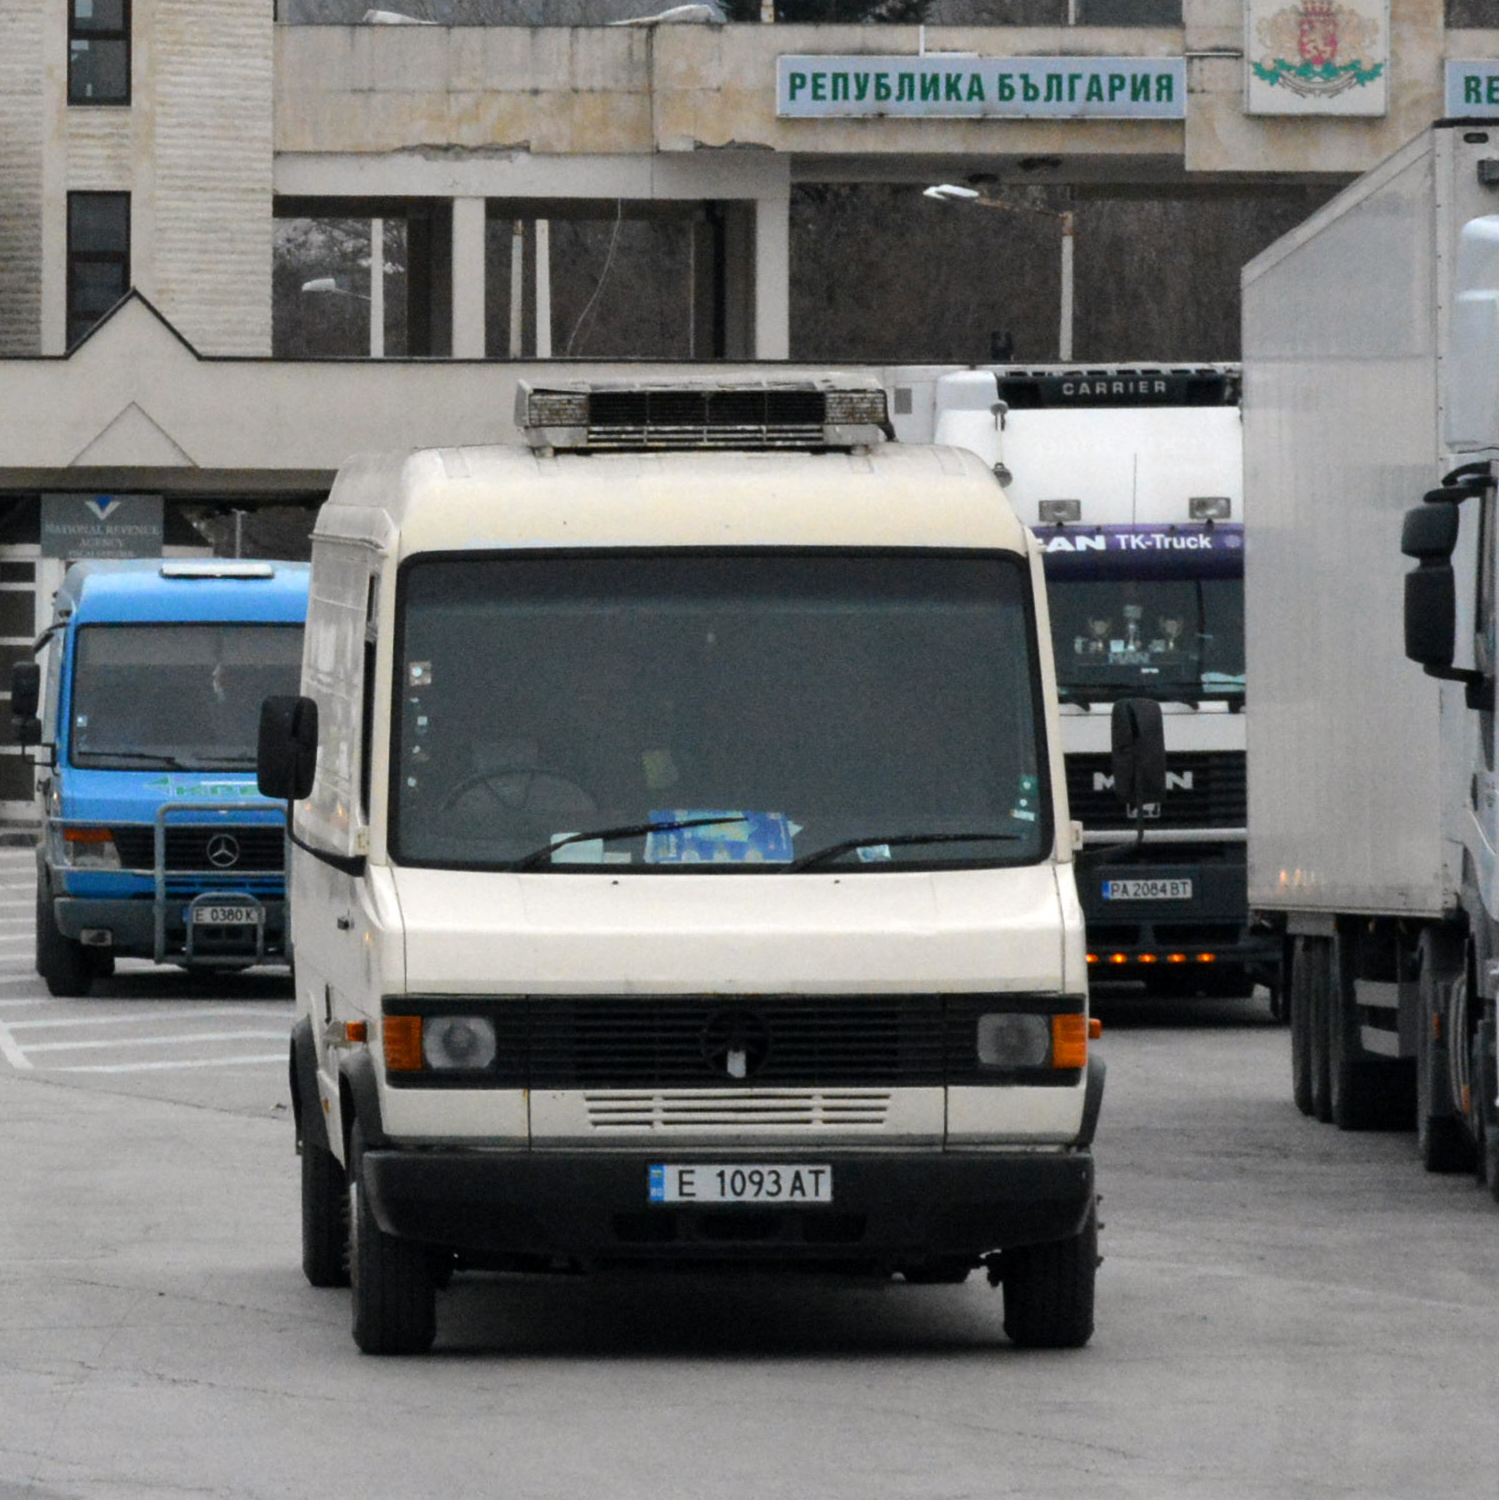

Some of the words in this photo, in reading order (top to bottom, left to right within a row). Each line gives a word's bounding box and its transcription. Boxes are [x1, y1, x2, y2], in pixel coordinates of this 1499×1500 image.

[788, 71, 986, 102] РЕПУБЛИКА
[997, 72, 1175, 103] БЪЛГАРИЯ
[1062, 381, 1166, 395] CARRIER
[1115, 534, 1212, 550] TK-Truck
[1093, 771, 1193, 791] MN
[1111, 883, 1129, 896] PA
[1133, 882, 1166, 896] 2084
[1171, 881, 1188, 896] BT
[195, 909, 204, 921] E
[211, 908, 243, 921] 0380
[678, 1169, 696, 1197] E
